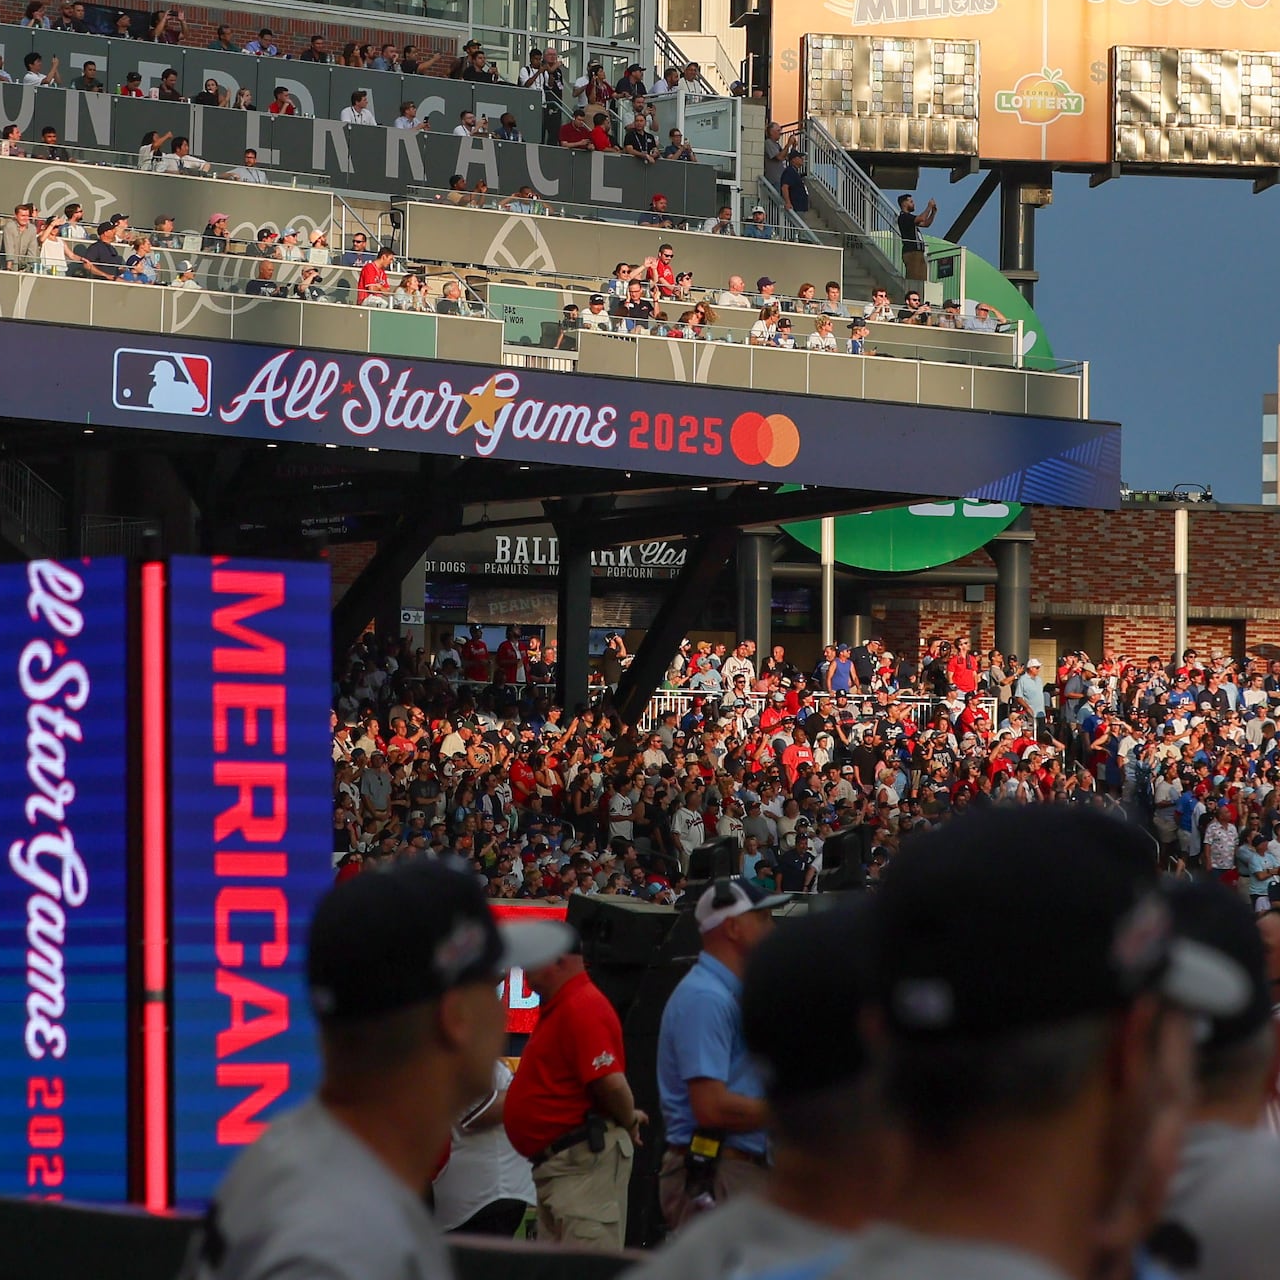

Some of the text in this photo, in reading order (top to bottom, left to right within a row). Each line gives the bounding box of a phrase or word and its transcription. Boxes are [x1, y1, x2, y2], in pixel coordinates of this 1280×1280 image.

[1001, 96, 1080, 110] LOTTERY
[220, 348, 723, 457] All Star Game 2025
[425, 561, 653, 580] OT DOGS PEANUTS POPCORN
[639, 541, 688, 568] Clas
[19, 637, 90, 818] Star
[211, 556, 290, 1147] MERICAN
[9, 813, 89, 1060] Game
[26, 1077, 65, 1201] 202
